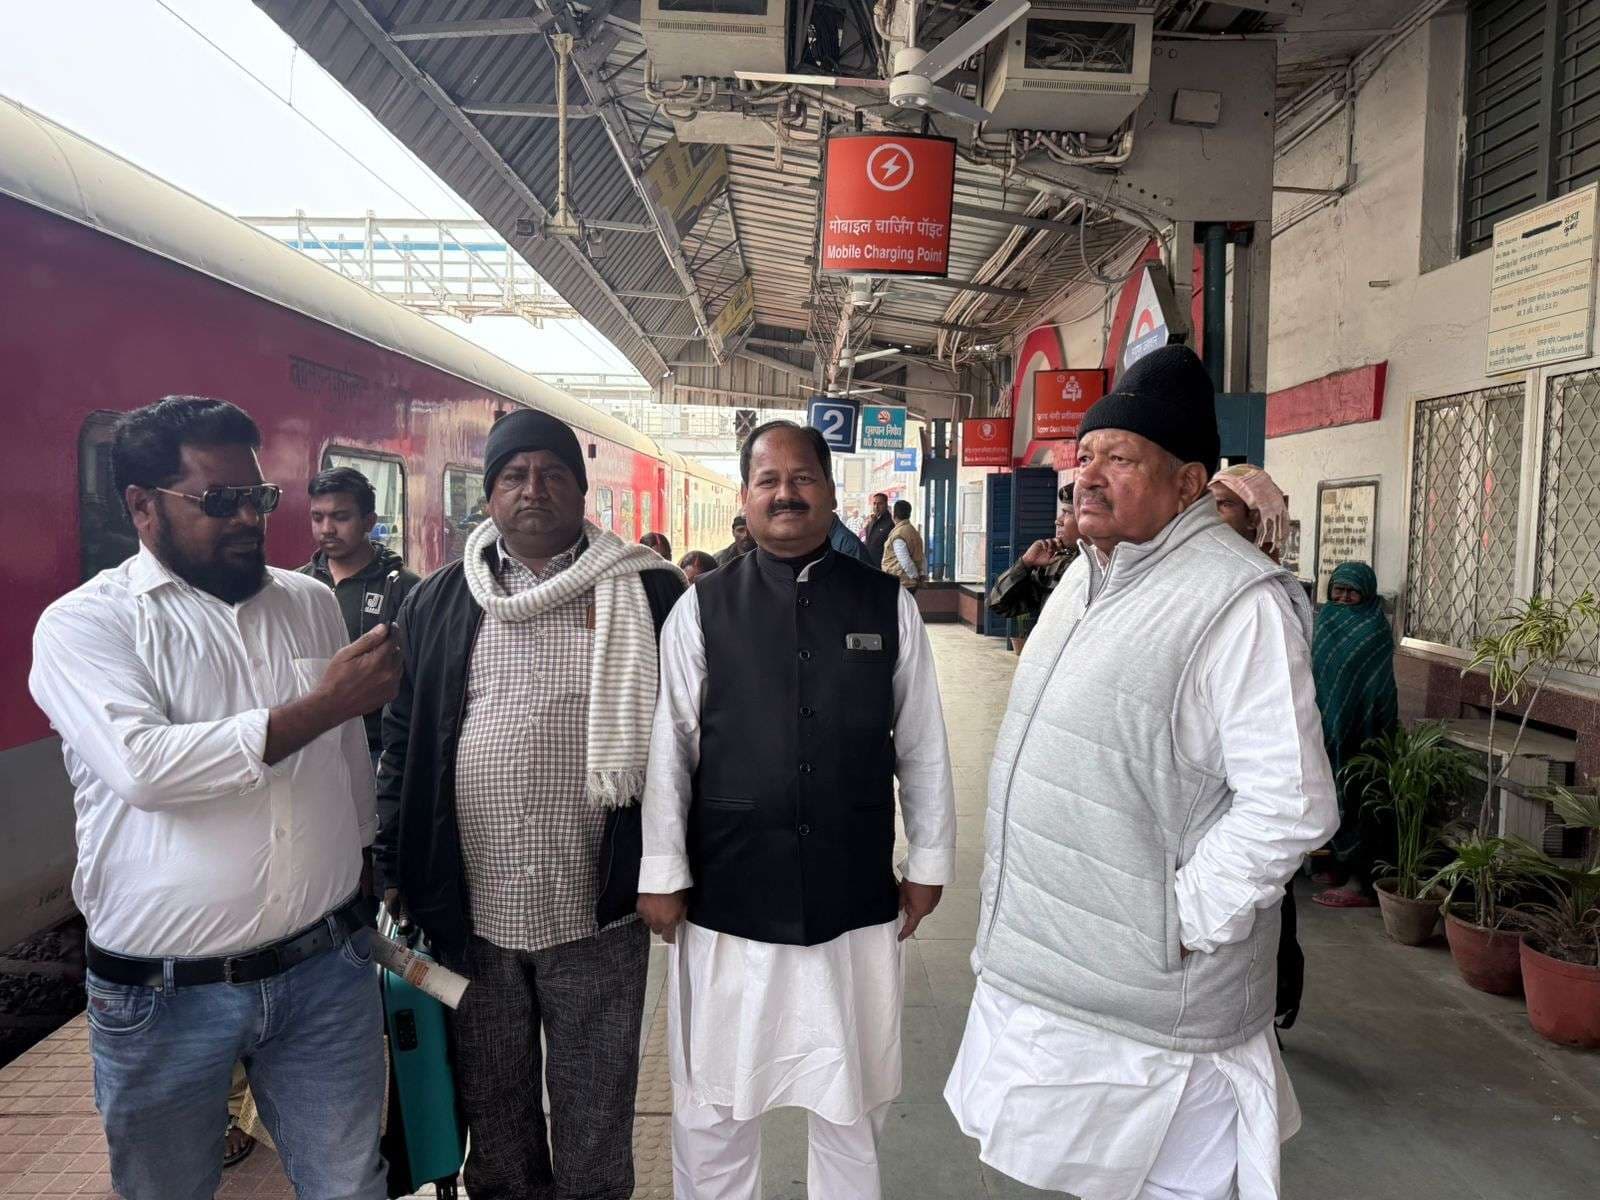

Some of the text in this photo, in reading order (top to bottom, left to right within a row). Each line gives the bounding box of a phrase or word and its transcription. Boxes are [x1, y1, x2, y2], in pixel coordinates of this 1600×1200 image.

[829, 216, 873, 236] मोबाइल
[917, 217, 945, 239] पॉइंट
[827, 244, 943, 263] Mobile Charging Point
[822, 409, 845, 441] 2
[863, 437, 903, 449] NO SMOKING
